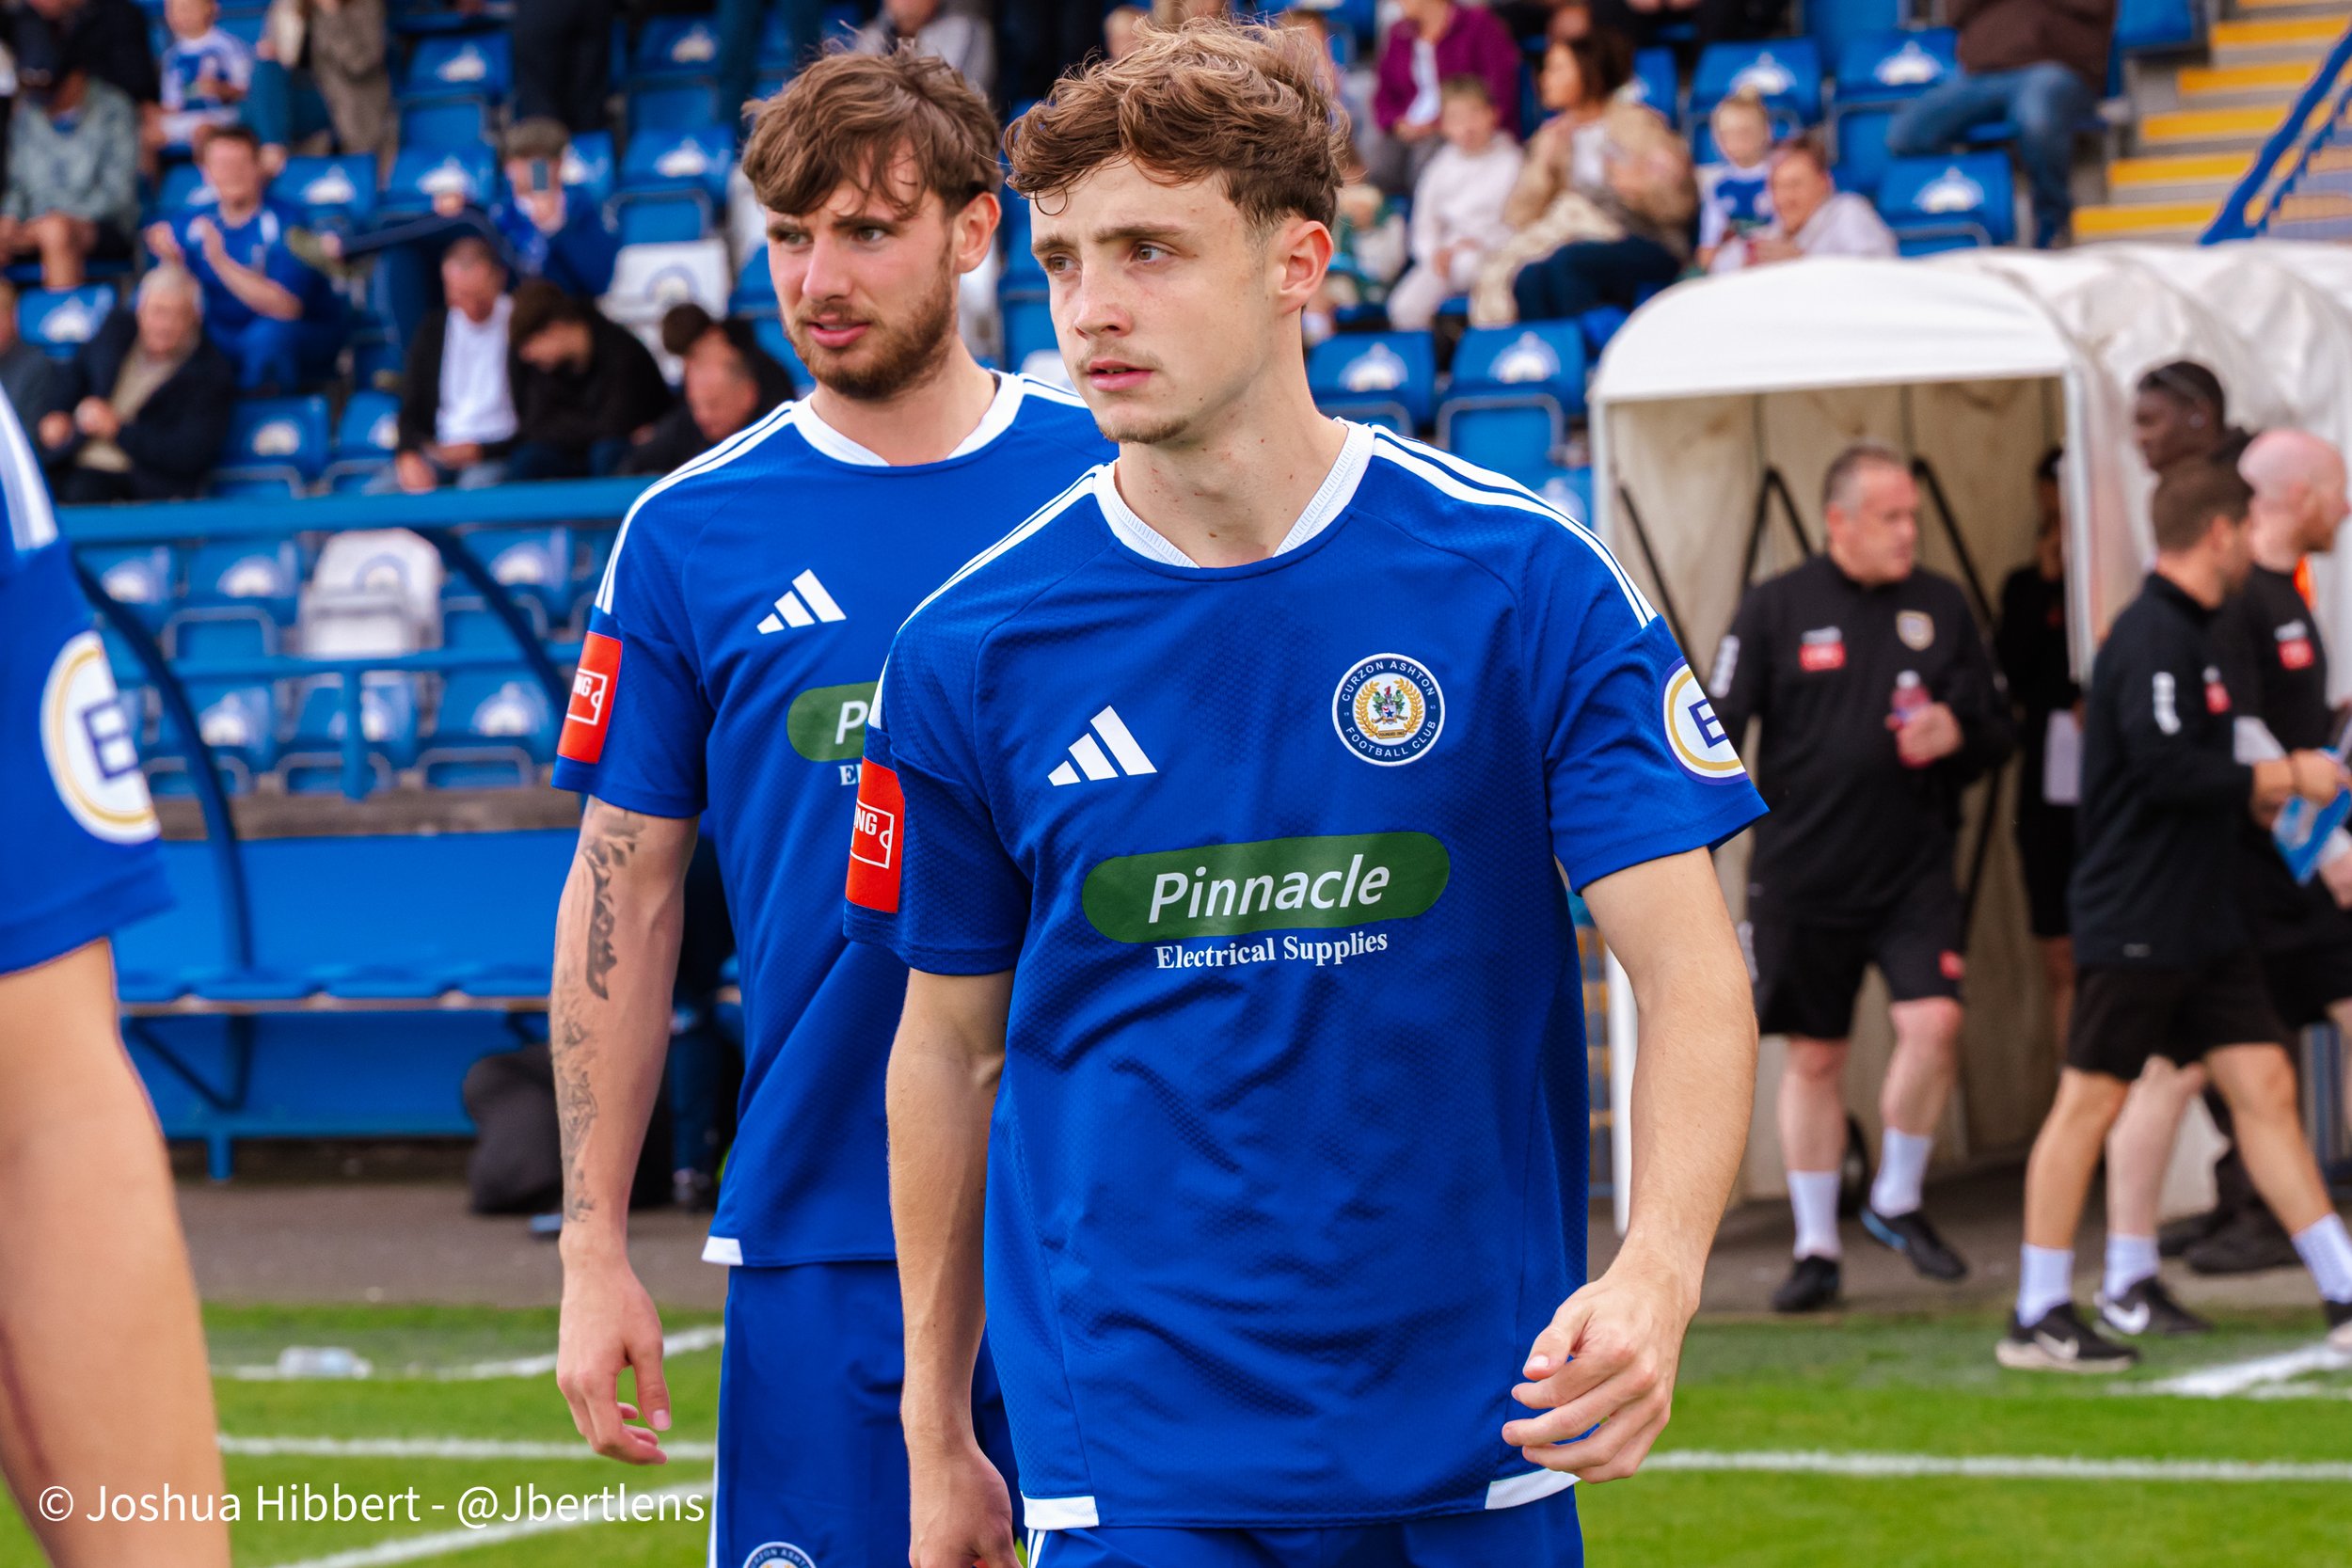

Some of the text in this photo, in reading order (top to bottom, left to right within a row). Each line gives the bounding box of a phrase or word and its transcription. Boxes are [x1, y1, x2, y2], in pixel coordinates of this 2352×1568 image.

[1342, 660, 1436, 702] CURZON ASHTON
[1345, 721, 1437, 757] FOOTBALL CLUB
[1687, 698, 1729, 749] E
[854, 806, 878, 836] NG
[1148, 853, 1391, 925] Pinnacle
[1153, 930, 1389, 970] Electrical Supplies
